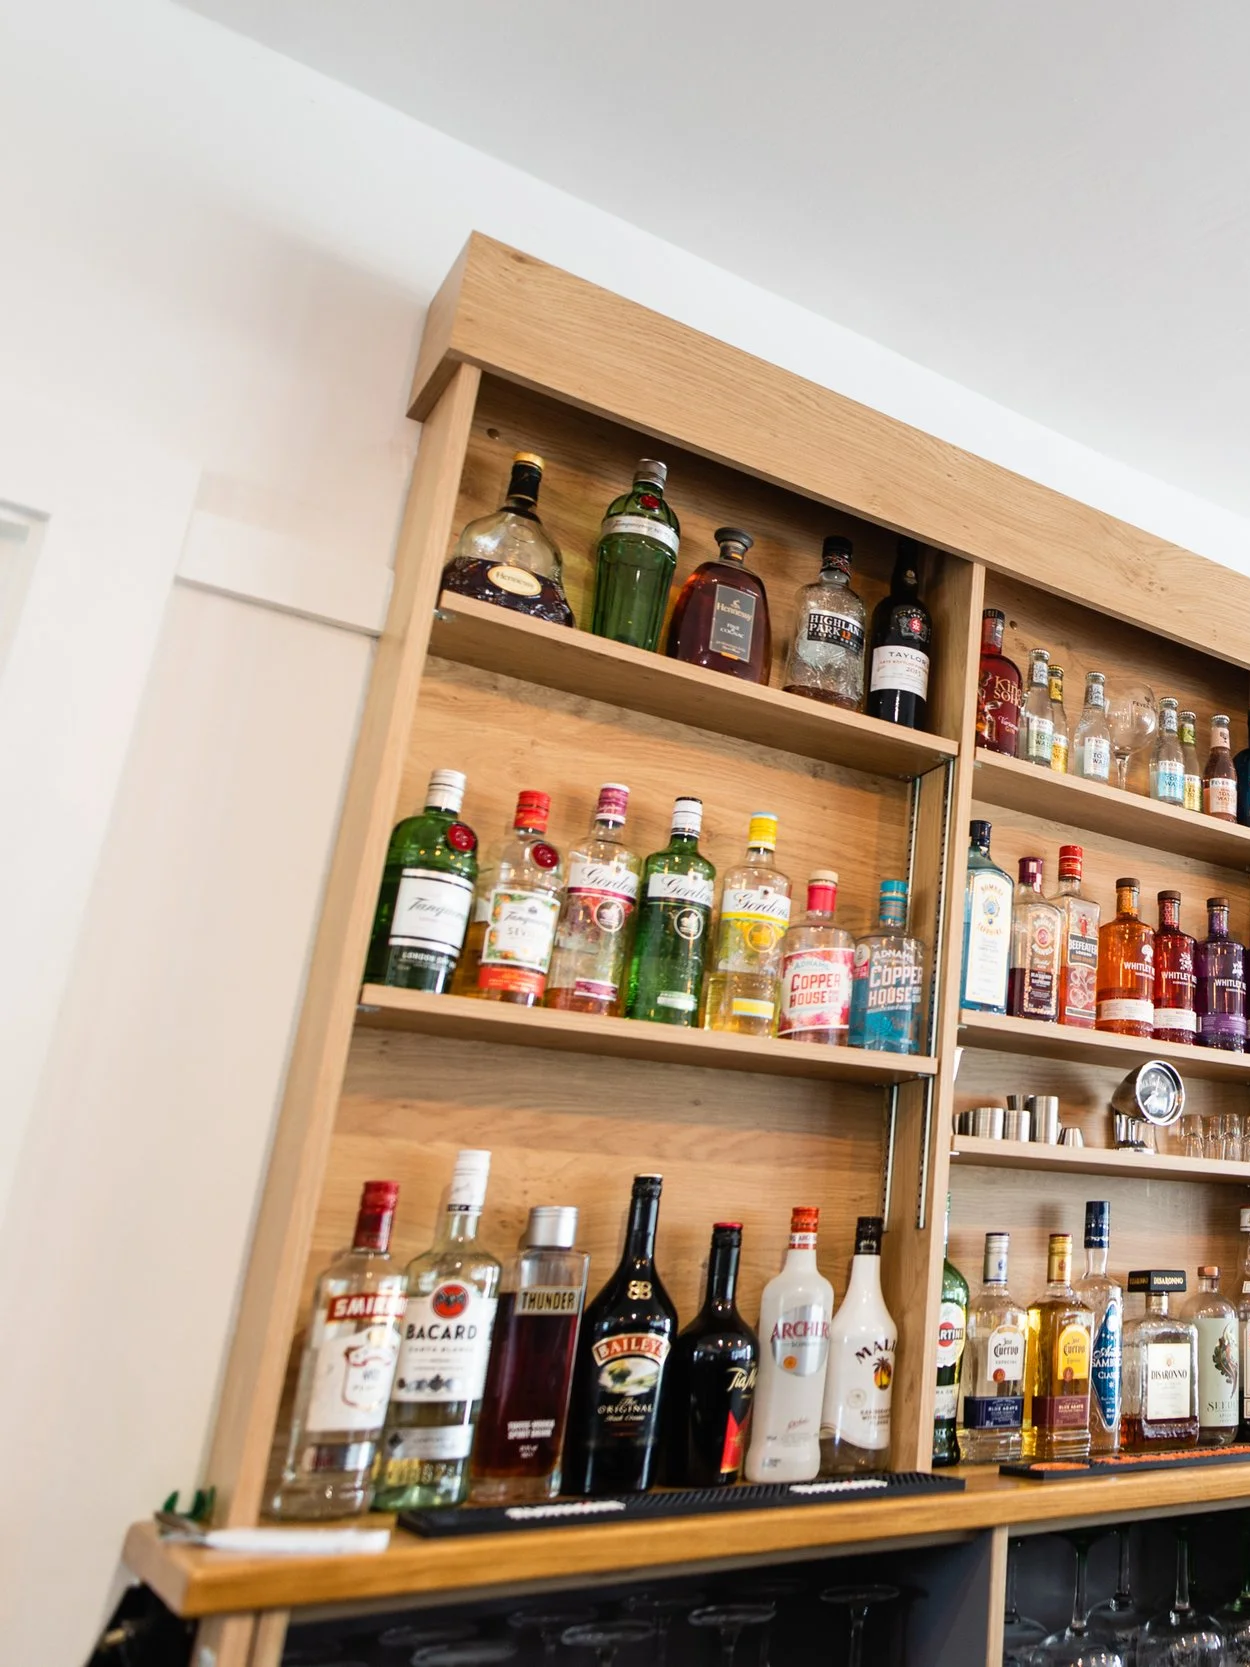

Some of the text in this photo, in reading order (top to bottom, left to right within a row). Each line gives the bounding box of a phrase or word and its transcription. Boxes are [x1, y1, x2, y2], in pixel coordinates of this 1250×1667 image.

[716, 601, 751, 622] Hennessy
[808, 623, 841, 637] PARK
[1069, 938, 1098, 956] BEEFEATER
[1123, 961, 1152, 974] WHITLEY
[791, 973, 841, 992] COPPER
[869, 966, 923, 988] COPPER
[1161, 971, 1191, 982] WHITLEY
[1215, 978, 1242, 989] WHITLEY
[789, 990, 827, 1008] HOUSE
[868, 986, 911, 1008] HOUSE
[1153, 1276, 1184, 1285] DISARONNO
[521, 1291, 576, 1310] THUNDER
[405, 1323, 479, 1340] BACARD
[993, 1341, 1019, 1357] Cuervo
[1063, 1341, 1085, 1357] Cuervo
[1151, 1369, 1188, 1381] DISARONNO
[597, 1404, 653, 1415] ORIGINAL
